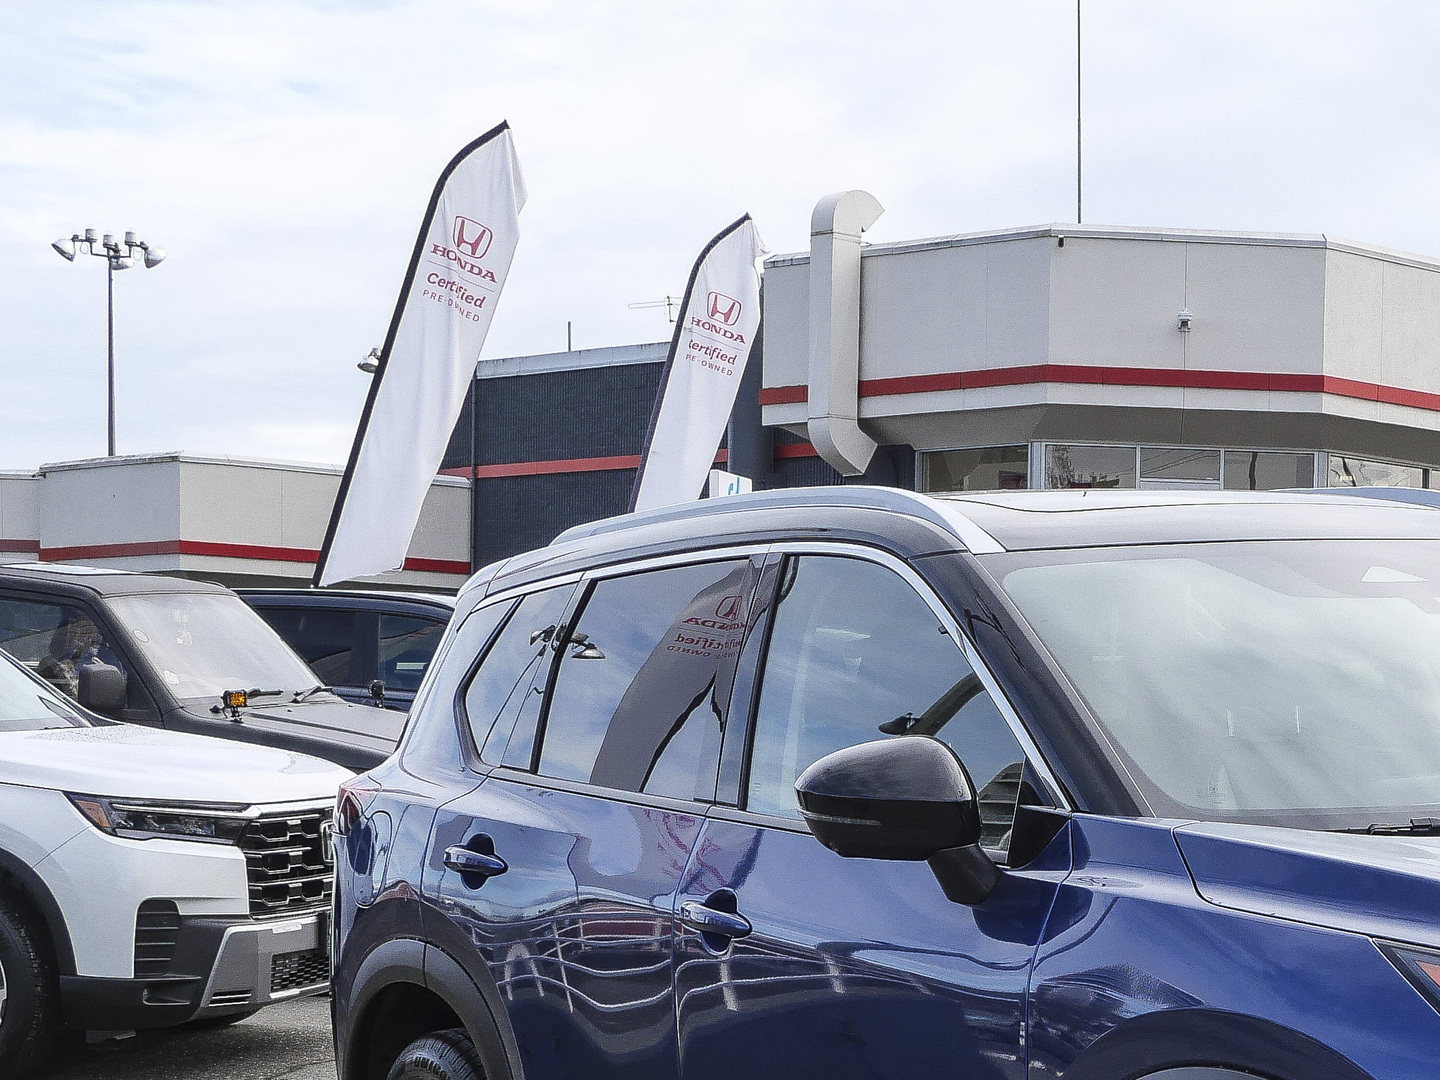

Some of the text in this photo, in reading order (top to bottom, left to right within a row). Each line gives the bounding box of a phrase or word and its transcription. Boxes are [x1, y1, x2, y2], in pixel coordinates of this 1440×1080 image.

[431, 243, 498, 283] HONDA
[427, 272, 487, 308] Certified
[691, 316, 746, 344] HONDA
[685, 354, 733, 376] PE-OWNED
